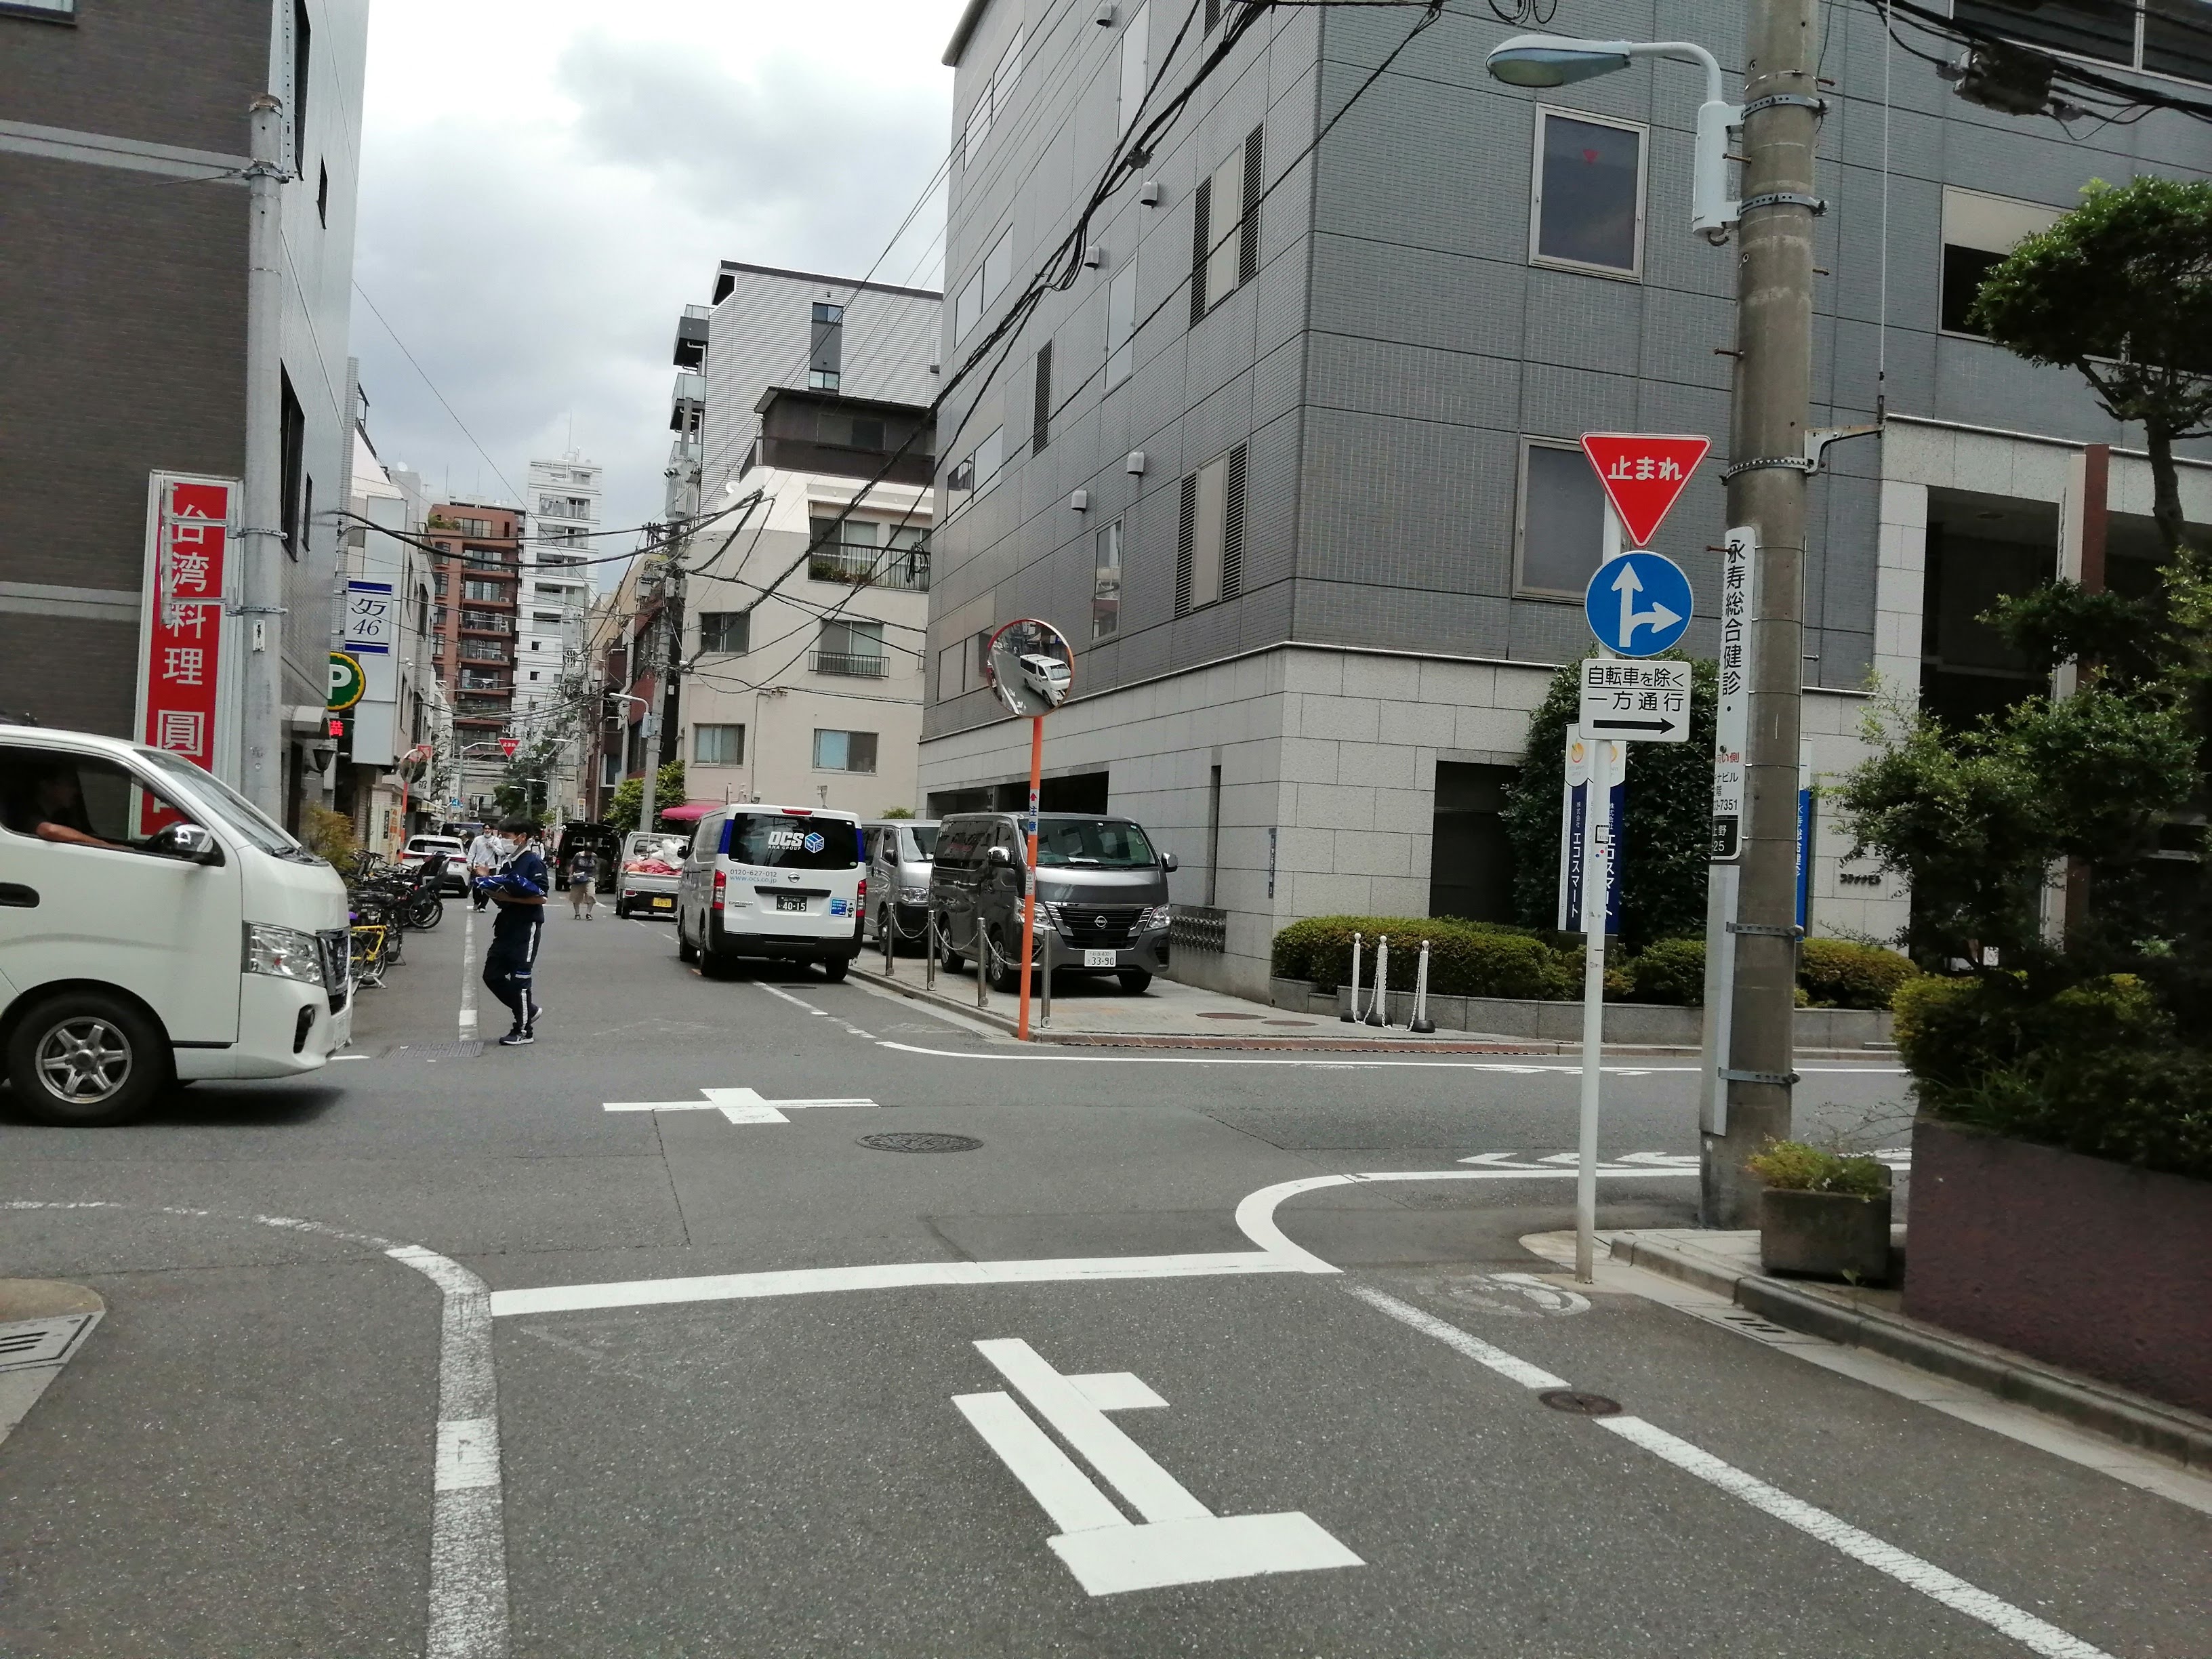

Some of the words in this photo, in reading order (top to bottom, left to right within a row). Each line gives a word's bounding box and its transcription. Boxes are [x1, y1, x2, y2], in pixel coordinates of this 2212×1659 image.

[1607, 455, 1683, 481] 止まれ
[163, 504, 209, 686] 台湾料理
[352, 619, 382, 636] 46
[327, 664, 352, 699] P
[1589, 665, 1684, 687] 自転車を除く
[1588, 691, 1684, 712] 一方通行
[1029, 806, 1038, 832] 注意
[768, 831, 804, 847] OCS
[730, 869, 777, 877] 0120-627-012
[730, 876, 777, 884] www.ocs.co.jp
[1571, 833, 1581, 918] エコスマート
[783, 901, 806, 911] 40-15
[1092, 957, 1114, 966] 33-90
